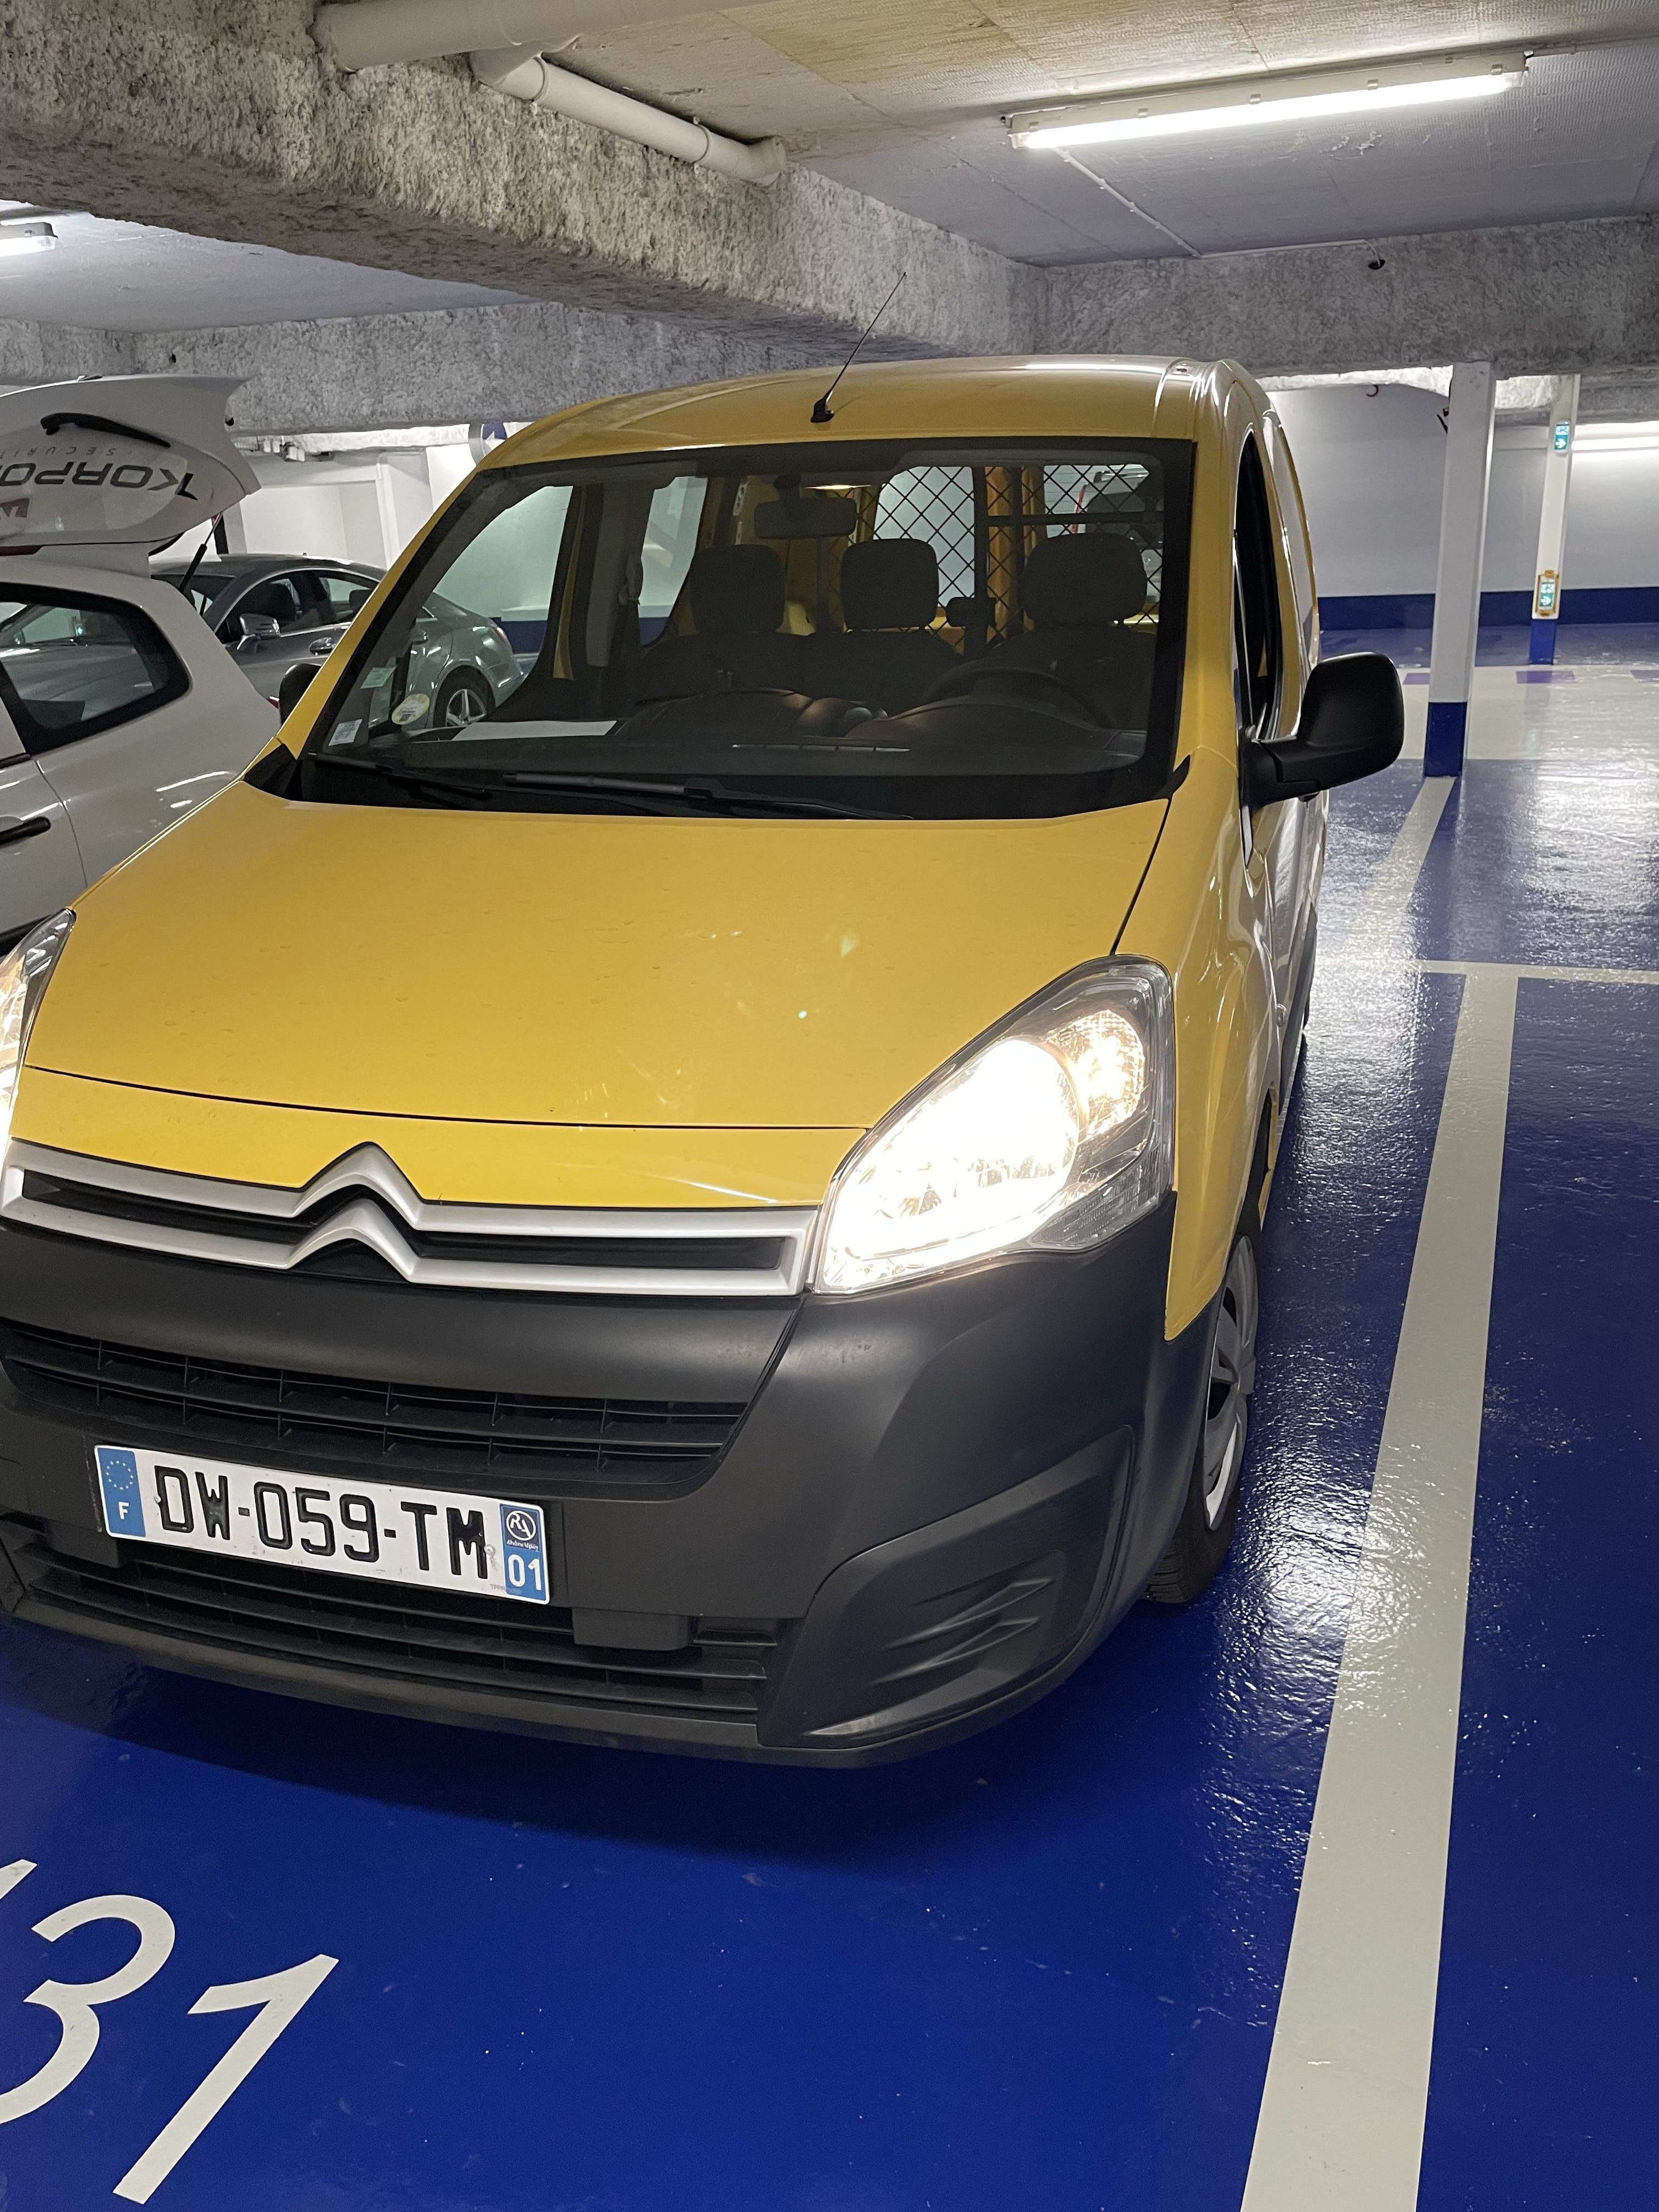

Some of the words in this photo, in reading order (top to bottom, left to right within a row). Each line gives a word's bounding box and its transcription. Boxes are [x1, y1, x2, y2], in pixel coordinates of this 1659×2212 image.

[0, 461, 198, 501] KORPO
[118, 1501, 129, 1520] F
[154, 1465, 488, 1579] DW-059-TM
[508, 1554, 542, 1590] 01
[0, 1859, 339, 2204] 31
